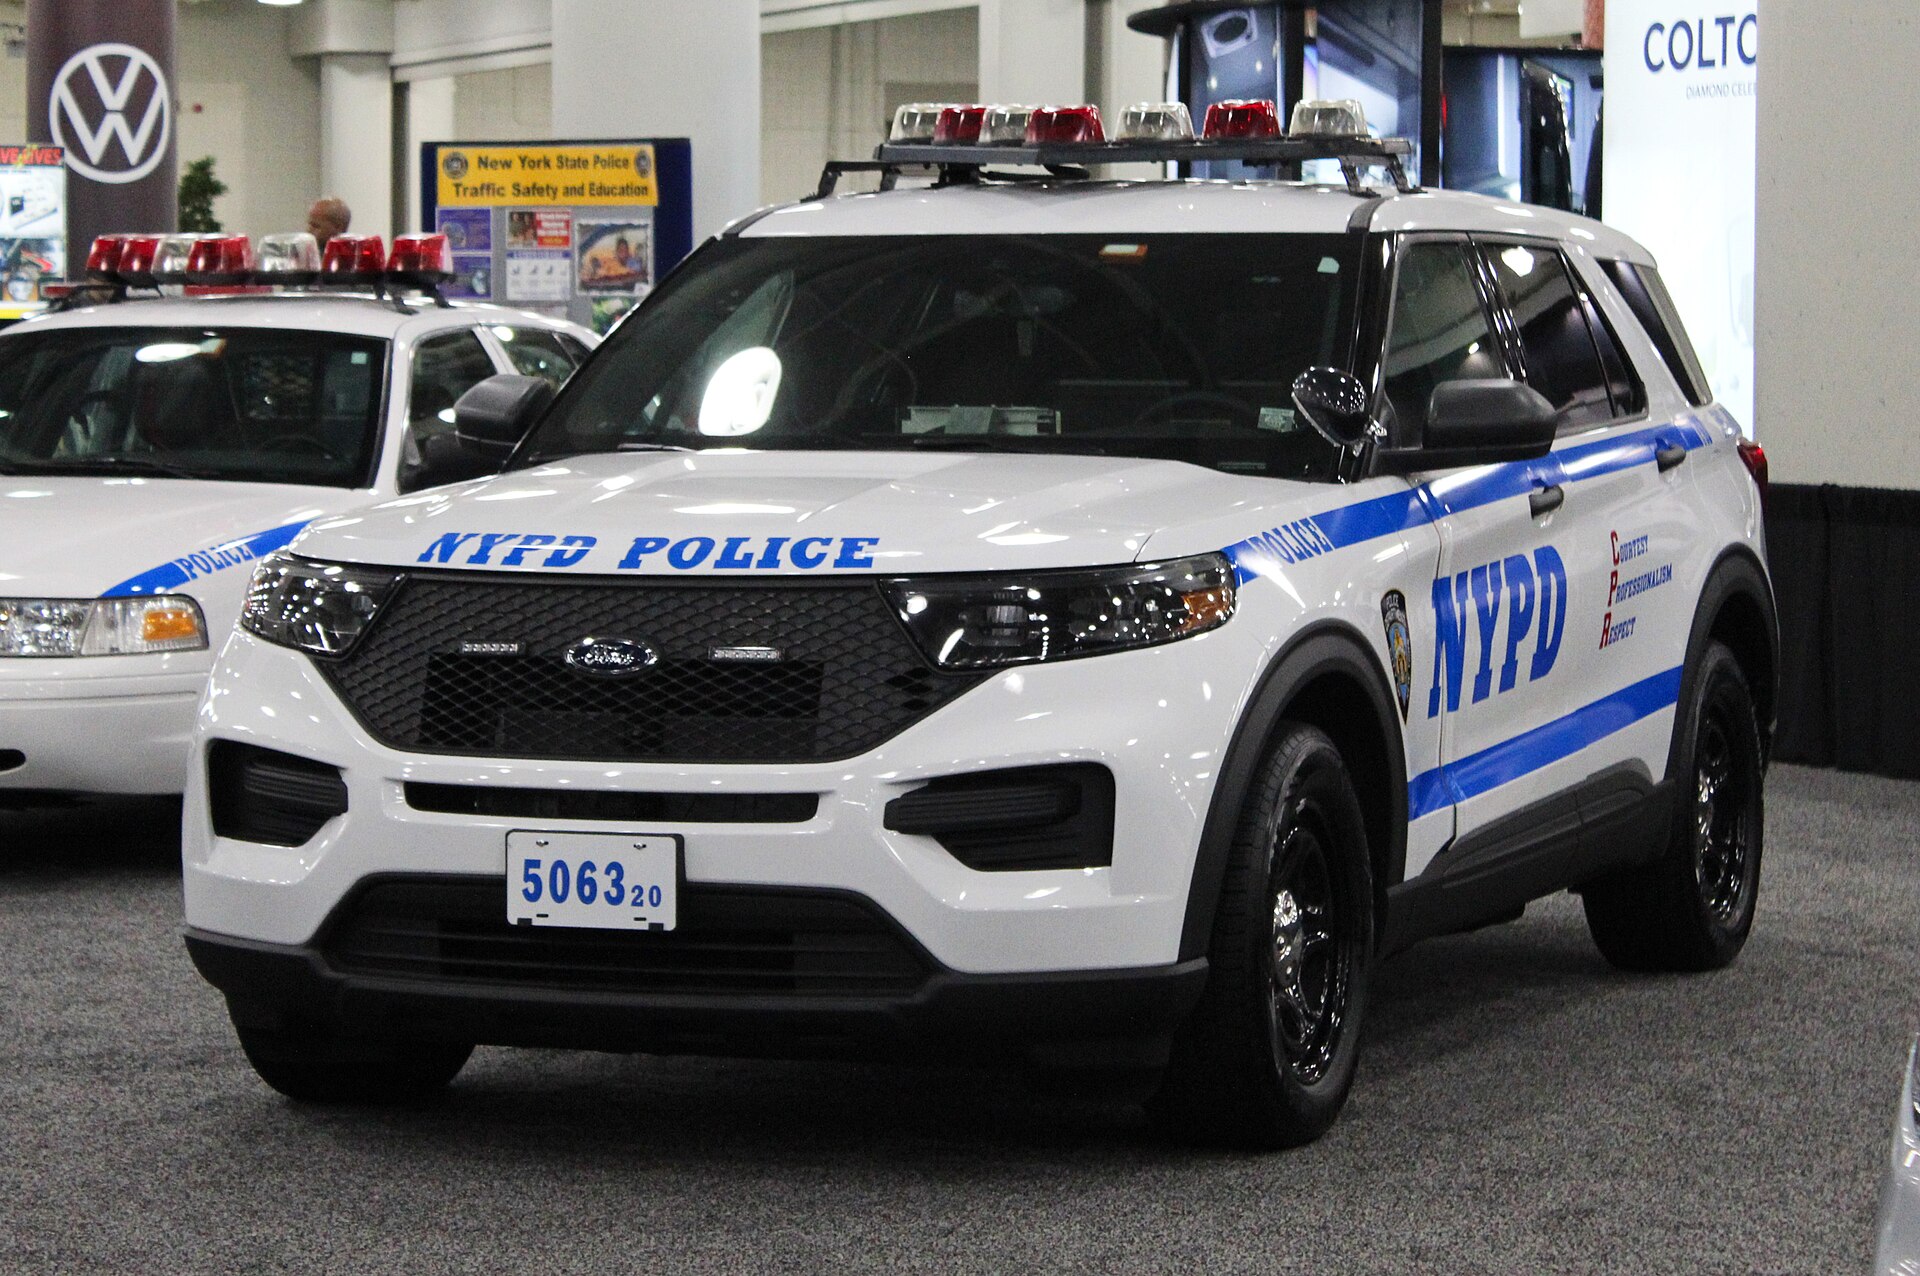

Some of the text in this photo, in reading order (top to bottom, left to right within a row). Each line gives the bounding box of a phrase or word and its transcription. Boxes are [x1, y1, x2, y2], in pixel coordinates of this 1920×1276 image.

[1643, 13, 1757, 72] COLTO
[1686, 83, 1729, 99] DIAMOND
[477, 153, 629, 170] New York State Police
[453, 181, 648, 201] Traffic Safety and Education
[416, 532, 880, 570] NYPD POLICE
[1247, 516, 1333, 564] POLICE
[1610, 529, 1649, 566] COURTESY
[172, 542, 254, 580] POLICE
[1607, 562, 1673, 607] PROFESSIONALISM
[1427, 545, 1567, 719] NYPD
[1599, 611, 1636, 650] RESPECT
